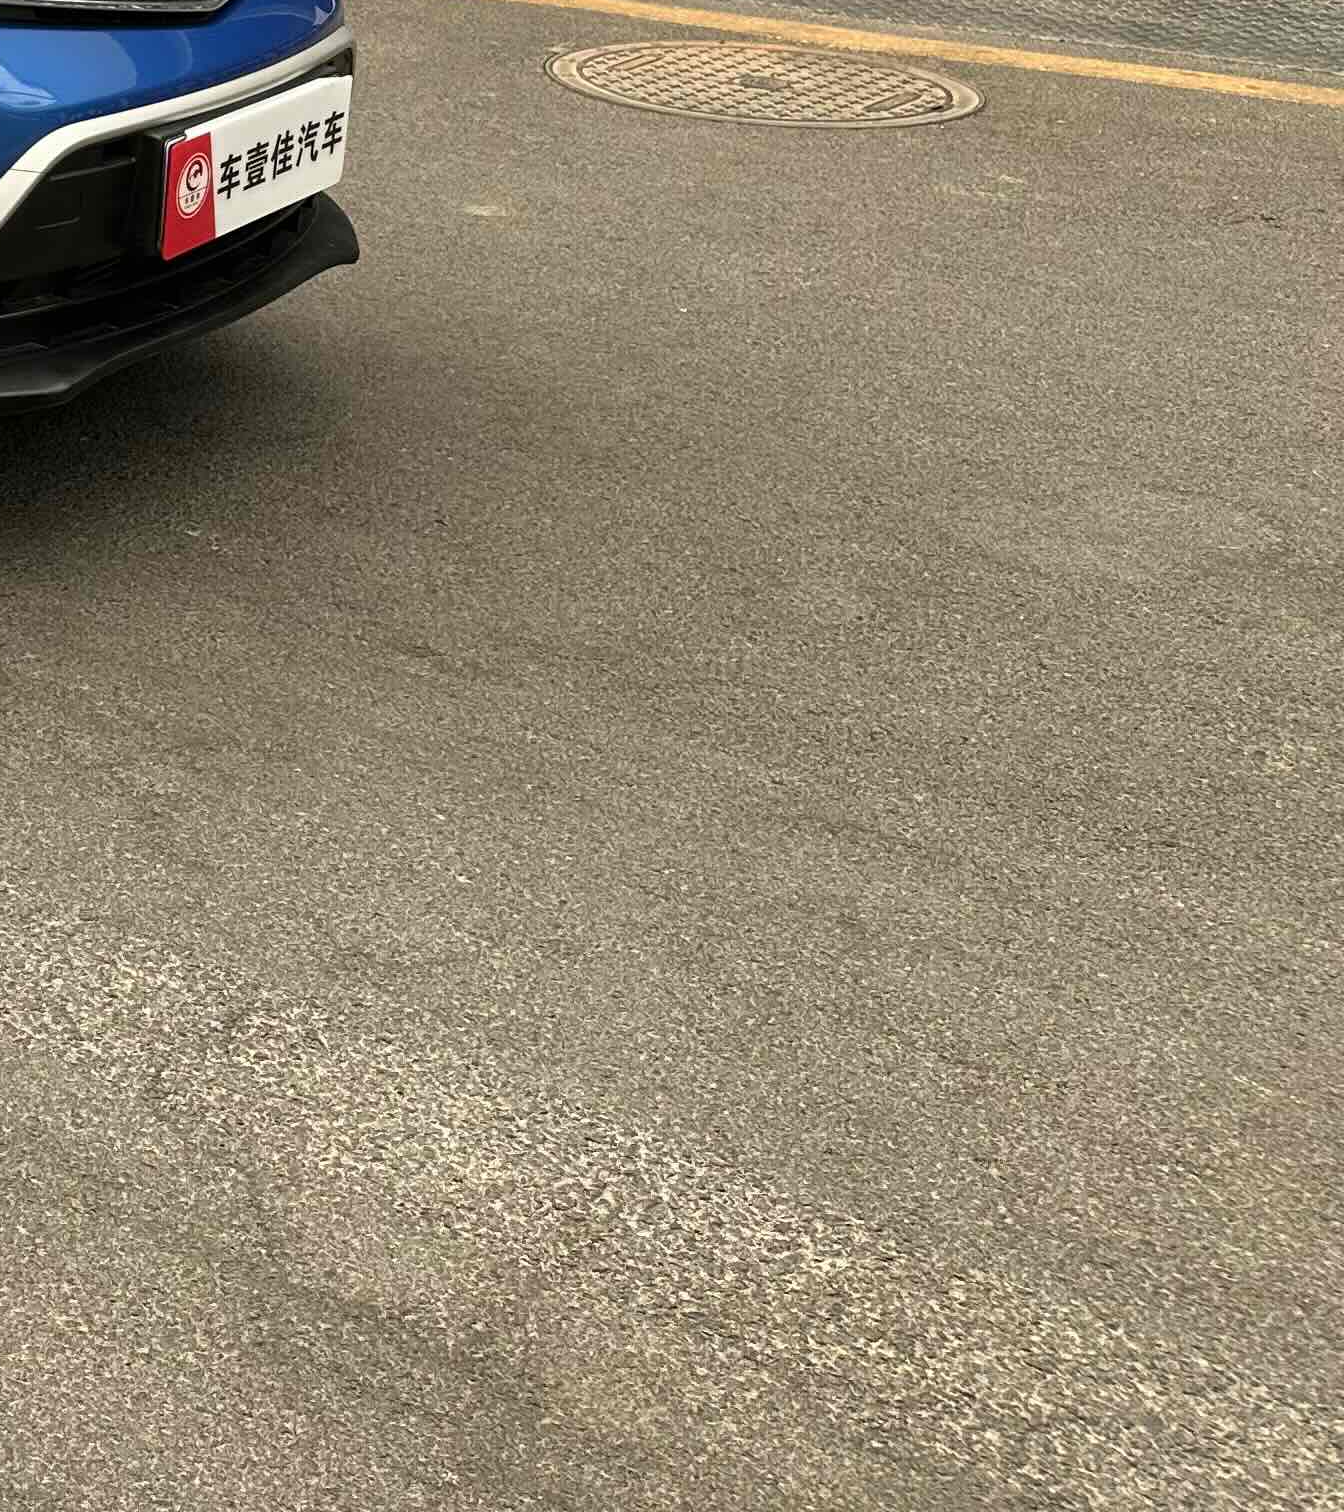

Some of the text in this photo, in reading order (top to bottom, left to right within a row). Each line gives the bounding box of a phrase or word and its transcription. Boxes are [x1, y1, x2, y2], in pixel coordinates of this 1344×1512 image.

[217, 111, 345, 199] 车壹佳汽车
